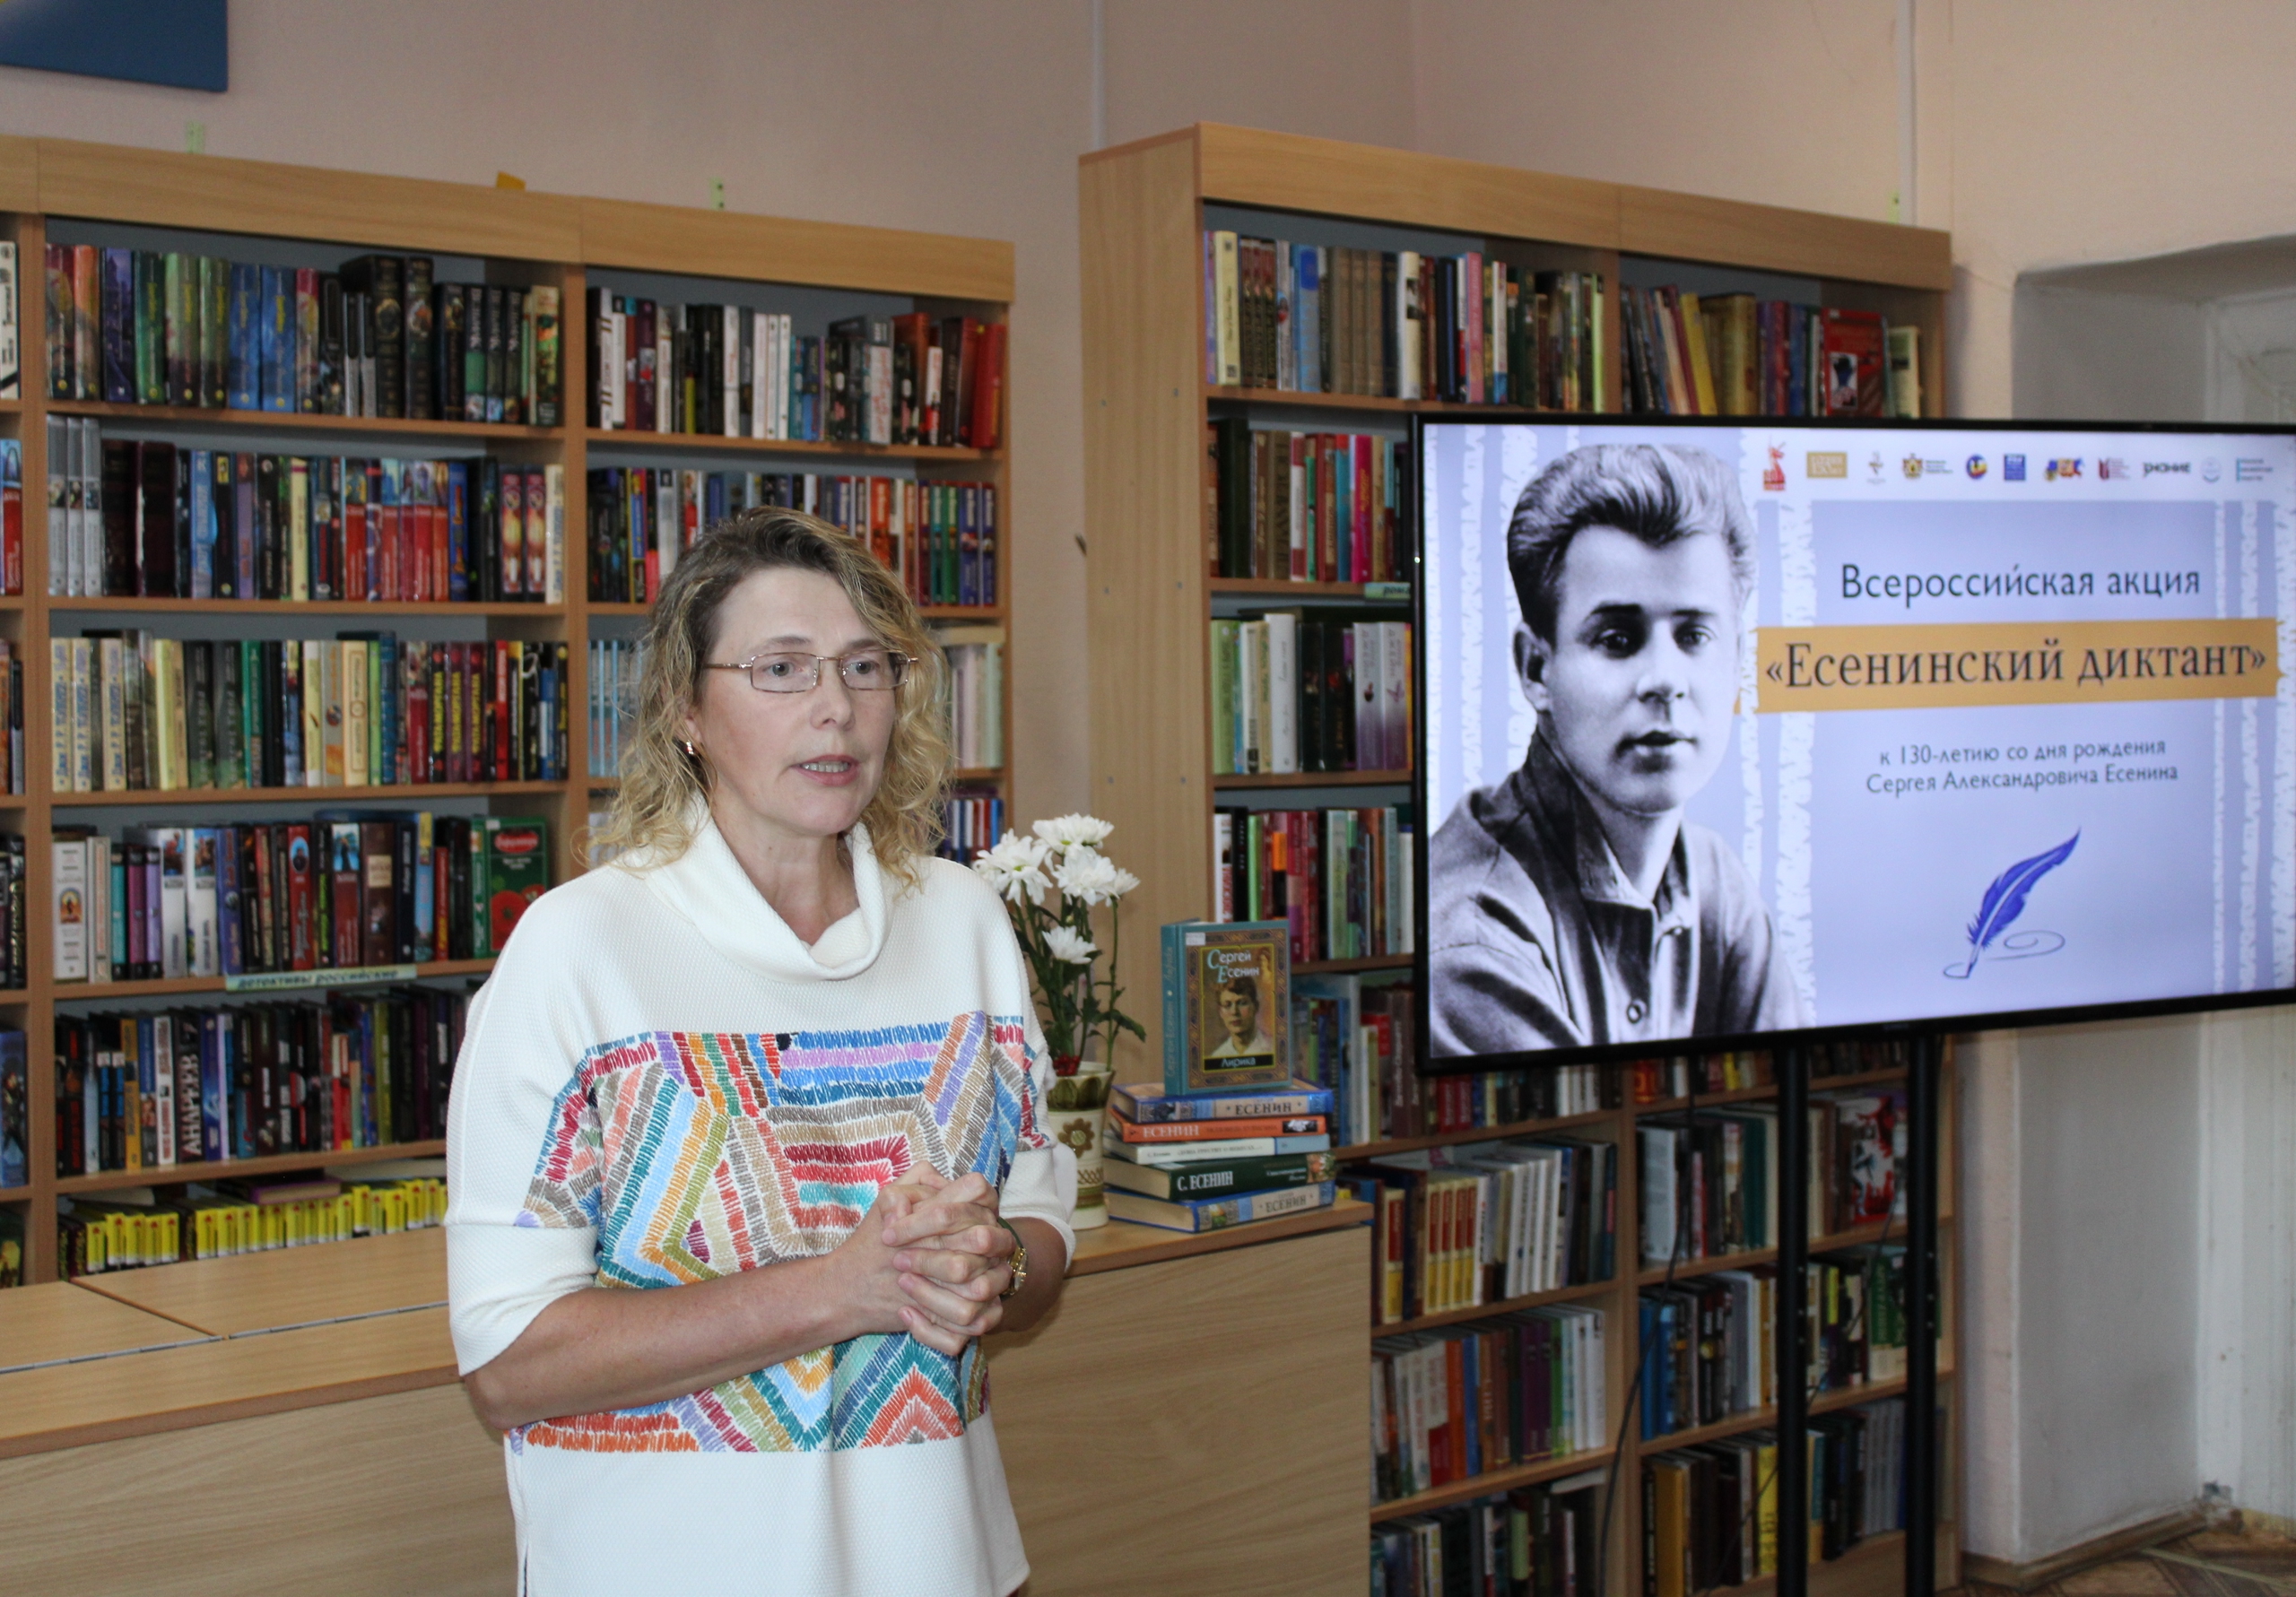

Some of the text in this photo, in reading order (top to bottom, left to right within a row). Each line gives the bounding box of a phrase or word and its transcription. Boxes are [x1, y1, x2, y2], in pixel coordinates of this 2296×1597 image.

[1841, 562, 2200, 608] Всероссийская акция
[1766, 638, 2268, 689] «Есенинский диктант»
[1880, 740, 2166, 766] к 130-летию со дня рождения
[1866, 762, 2179, 798] Сергея Александровича Есенина
[1207, 948, 1251, 969] Сергей
[1217, 964, 1260, 984] Есенин
[1221, 1056, 1257, 1069] Лирика
[180, 1053, 201, 1156] АНДРЕЕВ
[1235, 1102, 1292, 1116] ЕСЕНИН
[1143, 1124, 1200, 1138] ЕСЕНИН
[1177, 1170, 1234, 1192] С. ЕСЕНИН
[1265, 1197, 1307, 1213] ЕСЕНИН
